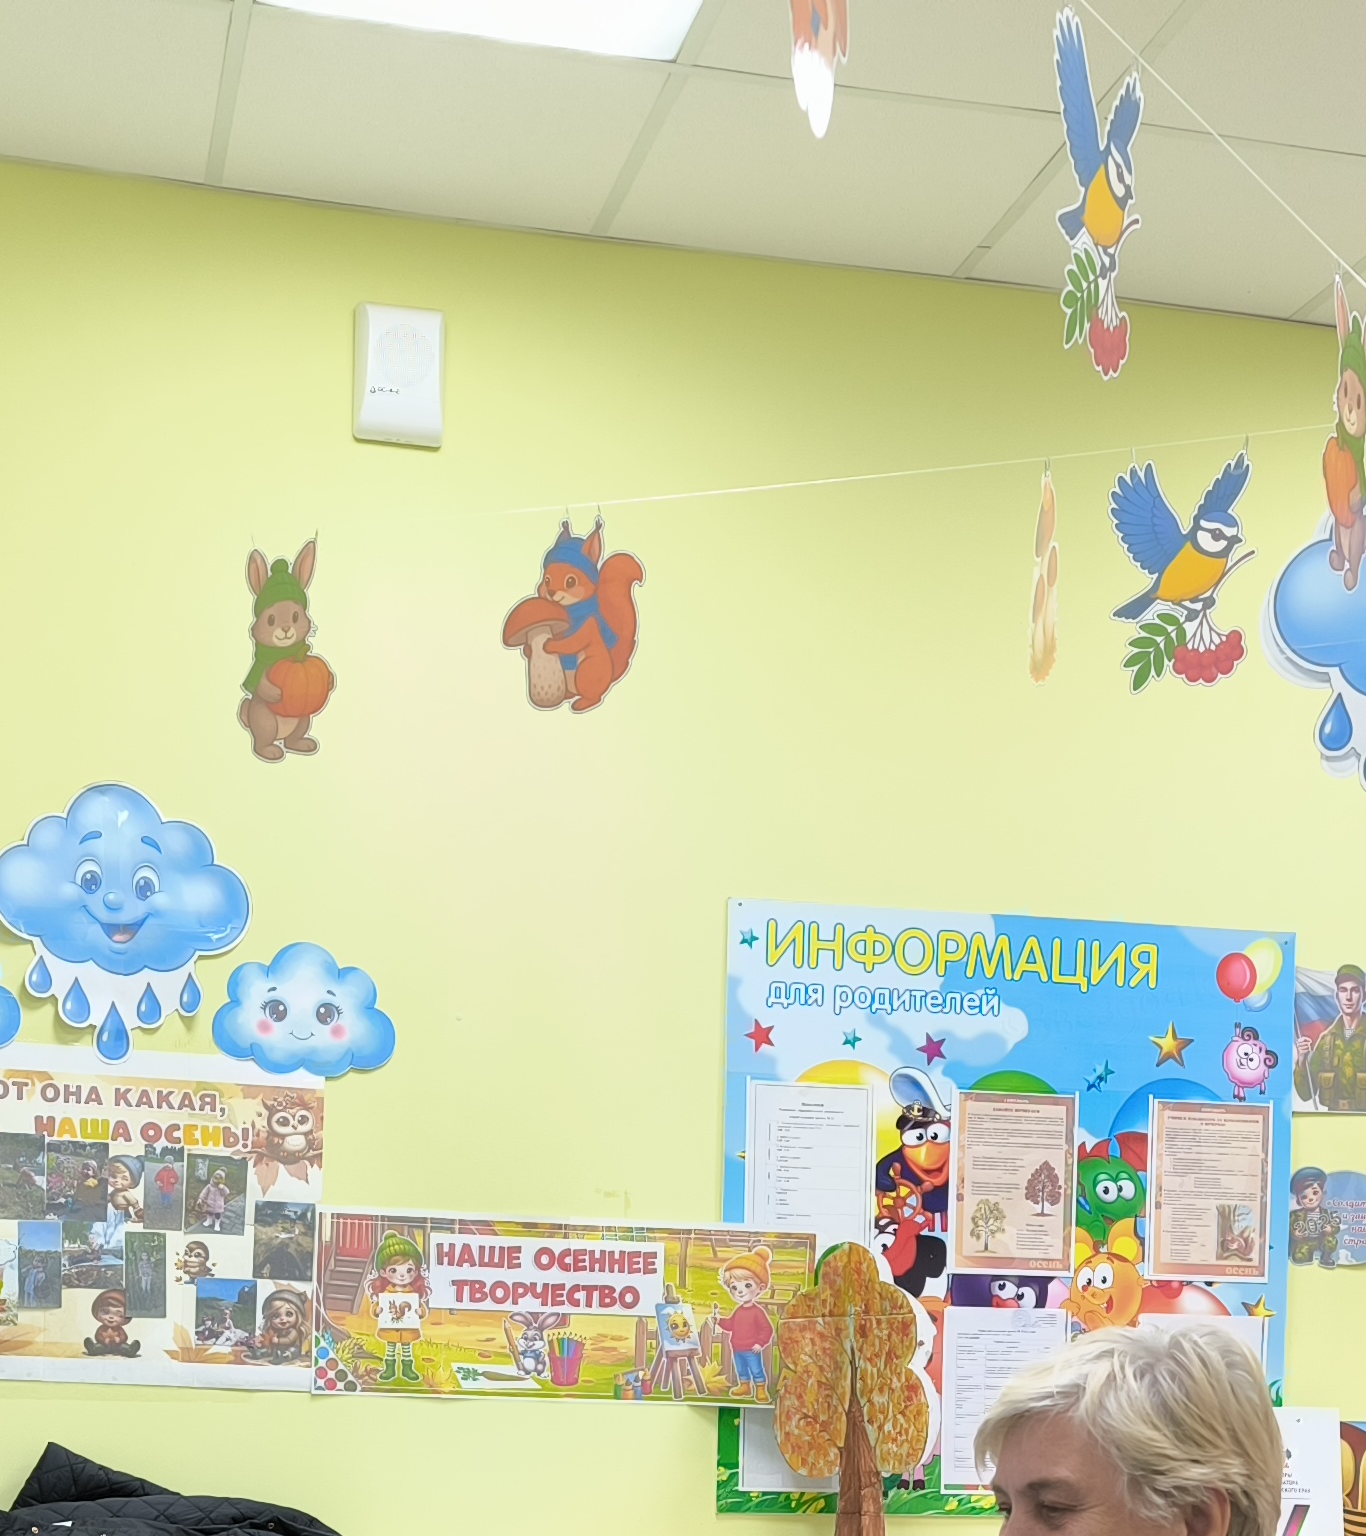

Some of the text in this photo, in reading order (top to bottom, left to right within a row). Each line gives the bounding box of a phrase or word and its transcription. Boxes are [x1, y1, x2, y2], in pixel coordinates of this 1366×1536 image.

[765, 918, 1159, 992] ИНФОРМАЦИЯ
[767, 980, 1002, 1018] для родителей
[40, 1082, 104, 1107] ОНА
[114, 1086, 227, 1118] КАКАЯ,
[35, 1114, 253, 1151] НАША ОСЕНЬ!
[436, 1242, 657, 1275] НАШЕ ОСЕННЕЕ
[451, 1279, 641, 1310] ТВОРЧЕСТВО
